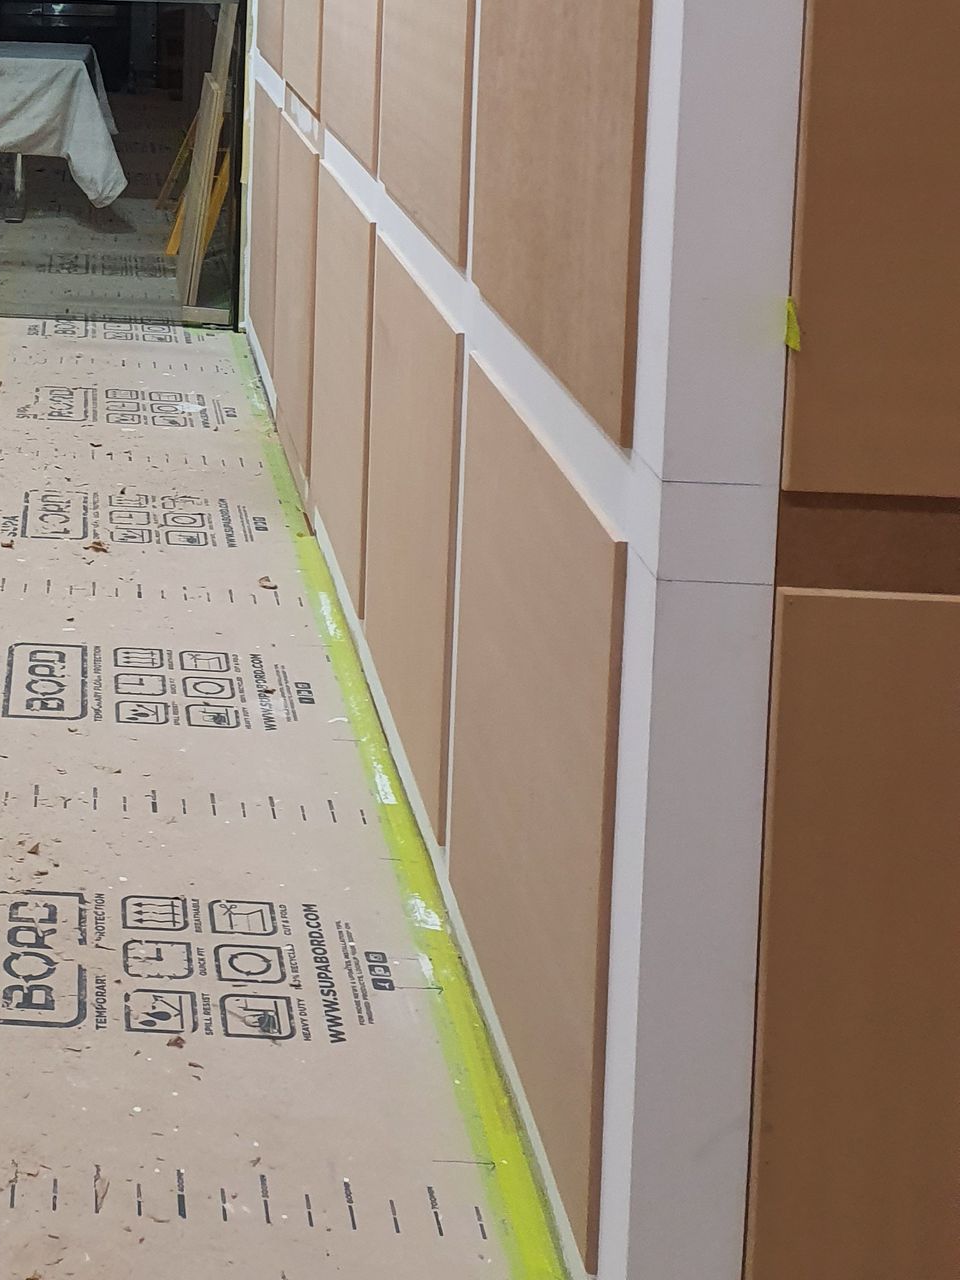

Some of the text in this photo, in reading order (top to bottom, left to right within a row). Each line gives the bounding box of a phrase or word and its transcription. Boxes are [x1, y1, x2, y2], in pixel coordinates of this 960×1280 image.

[1, 901, 58, 1011] BORD
[301, 903, 347, 1045] WWW.SUPABORD.COM
[201, 992, 214, 1036] SPILL RESIST
[297, 997, 312, 1042] HEAVY DUTY
